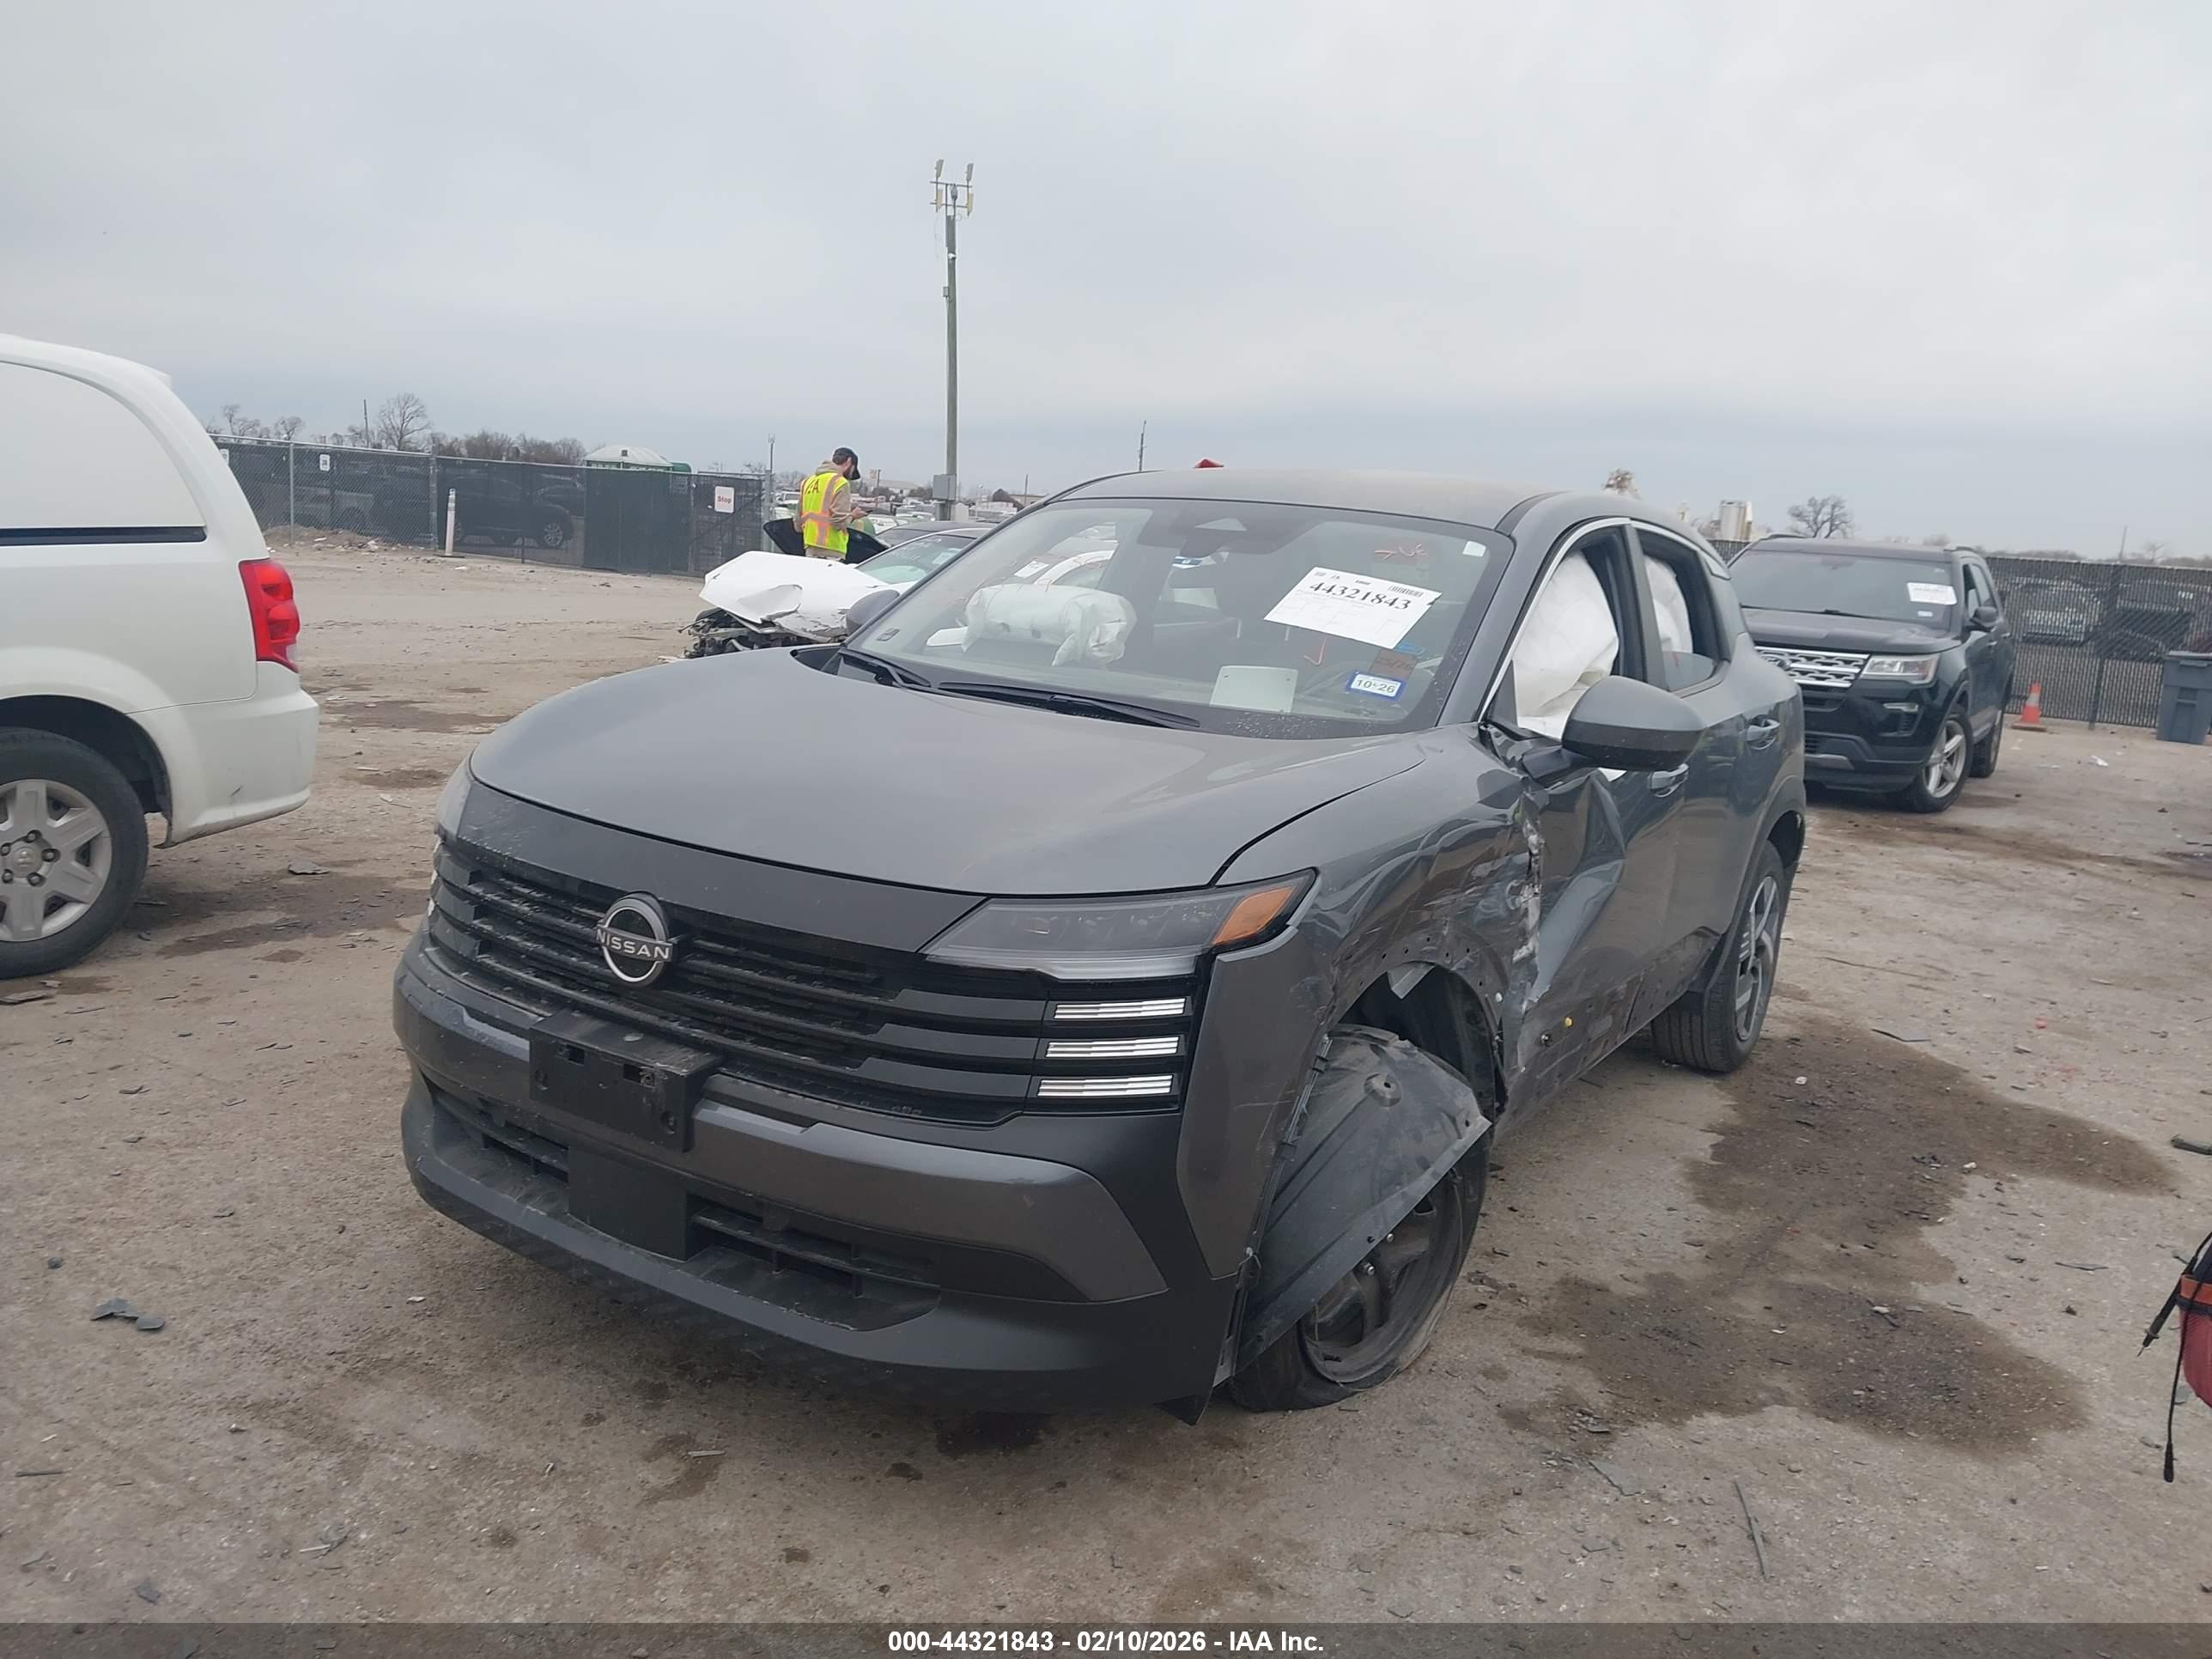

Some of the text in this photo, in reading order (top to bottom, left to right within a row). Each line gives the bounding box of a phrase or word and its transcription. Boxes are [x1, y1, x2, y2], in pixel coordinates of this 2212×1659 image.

[717, 495, 732, 505] Stop
[1309, 581, 1413, 611] 44321843
[596, 927, 670, 960] NISSAN
